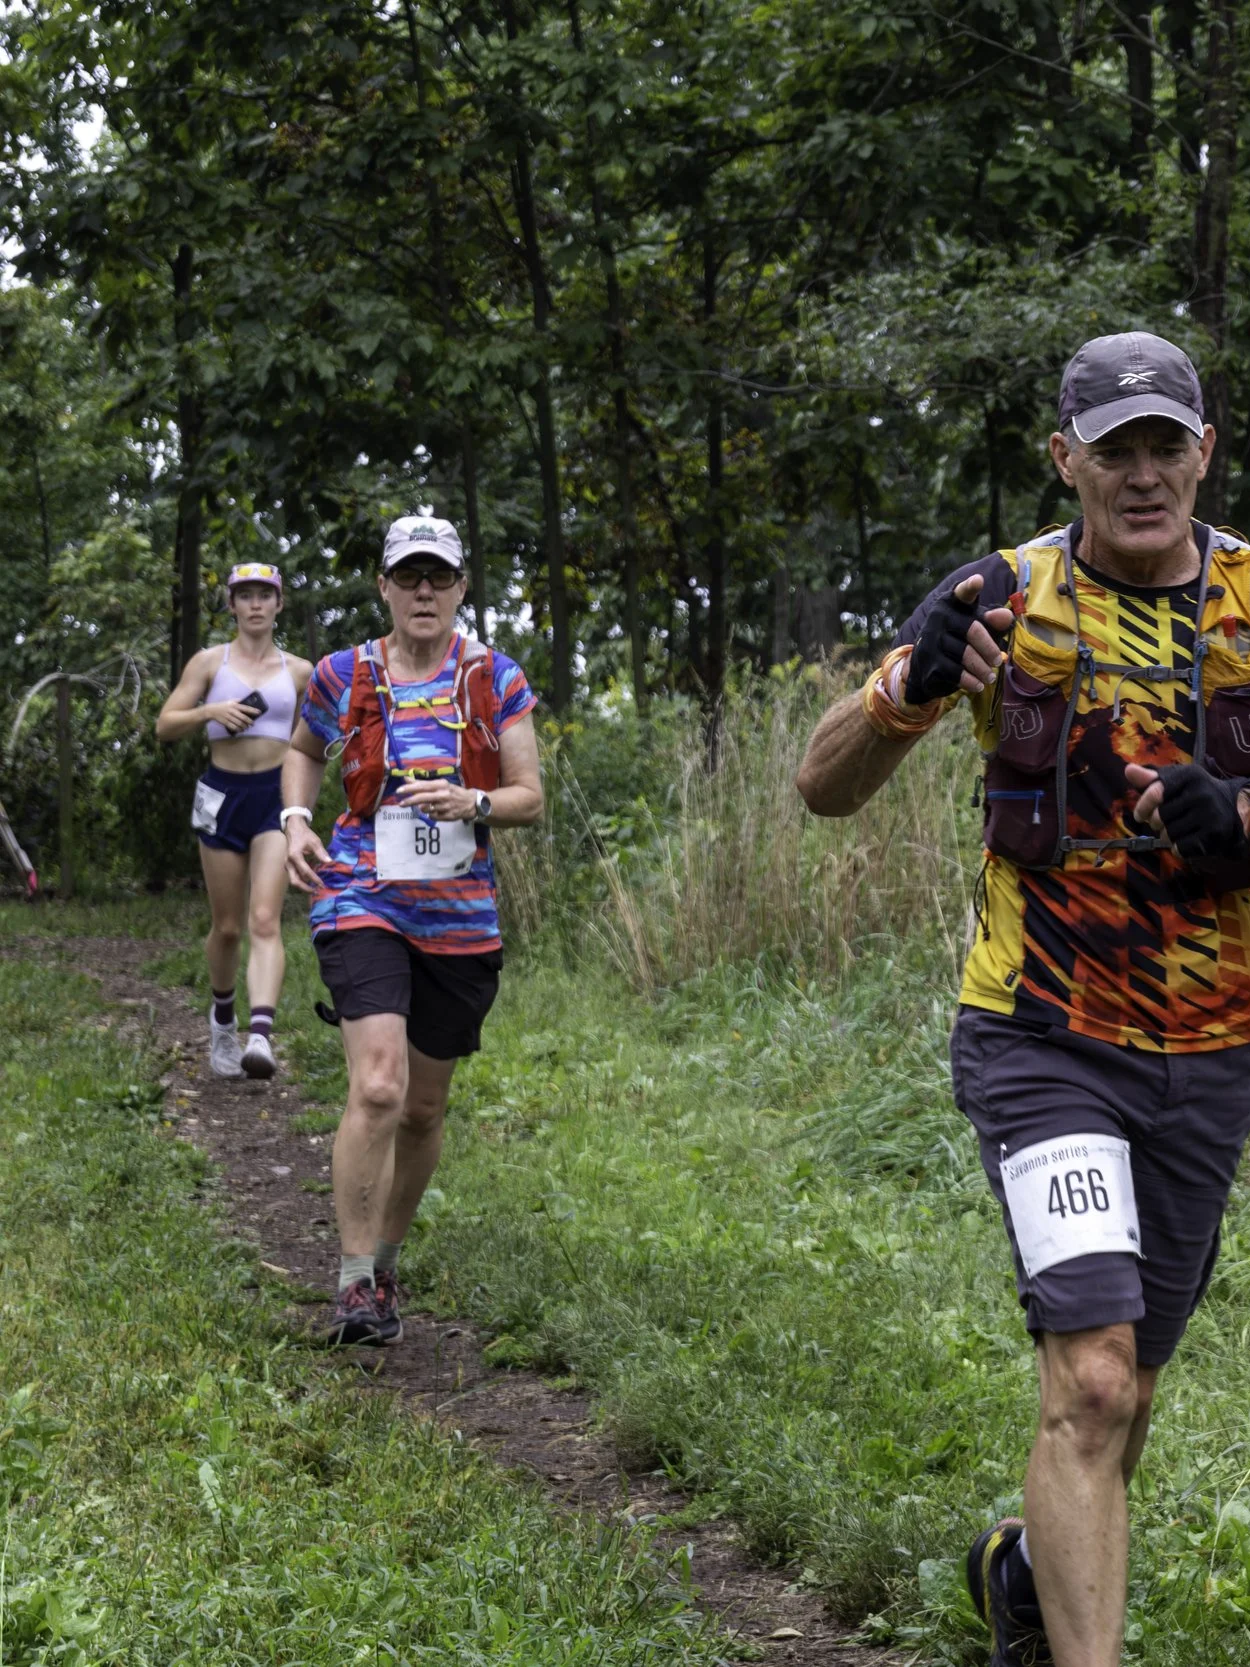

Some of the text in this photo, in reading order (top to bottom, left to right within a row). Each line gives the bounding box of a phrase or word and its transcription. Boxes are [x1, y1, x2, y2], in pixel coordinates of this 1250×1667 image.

[414, 826, 440, 855] 58
[1009, 1153, 1049, 1181] Savanna
[1050, 1144, 1088, 1163] series
[1048, 1168, 1110, 1218] 466
